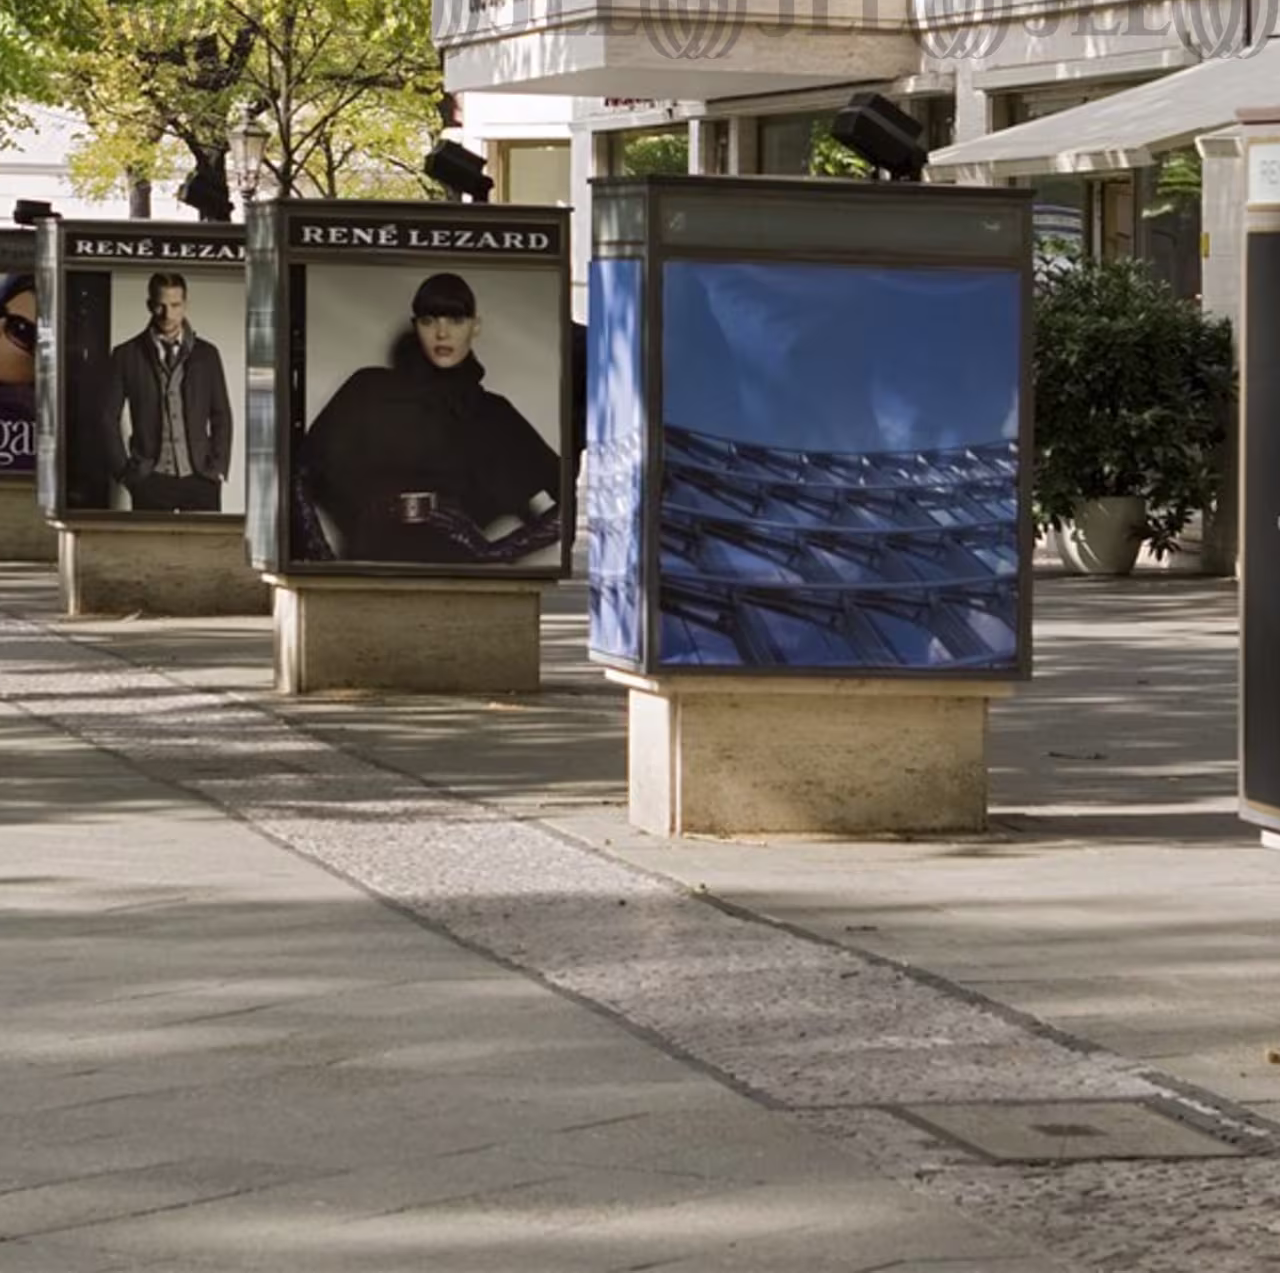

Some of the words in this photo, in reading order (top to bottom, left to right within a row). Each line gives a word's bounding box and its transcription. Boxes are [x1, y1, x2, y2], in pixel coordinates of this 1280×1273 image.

[75, 239, 154, 256] RENÉ
[302, 223, 400, 246] RENÉ
[408, 229, 550, 250] LEZARD
